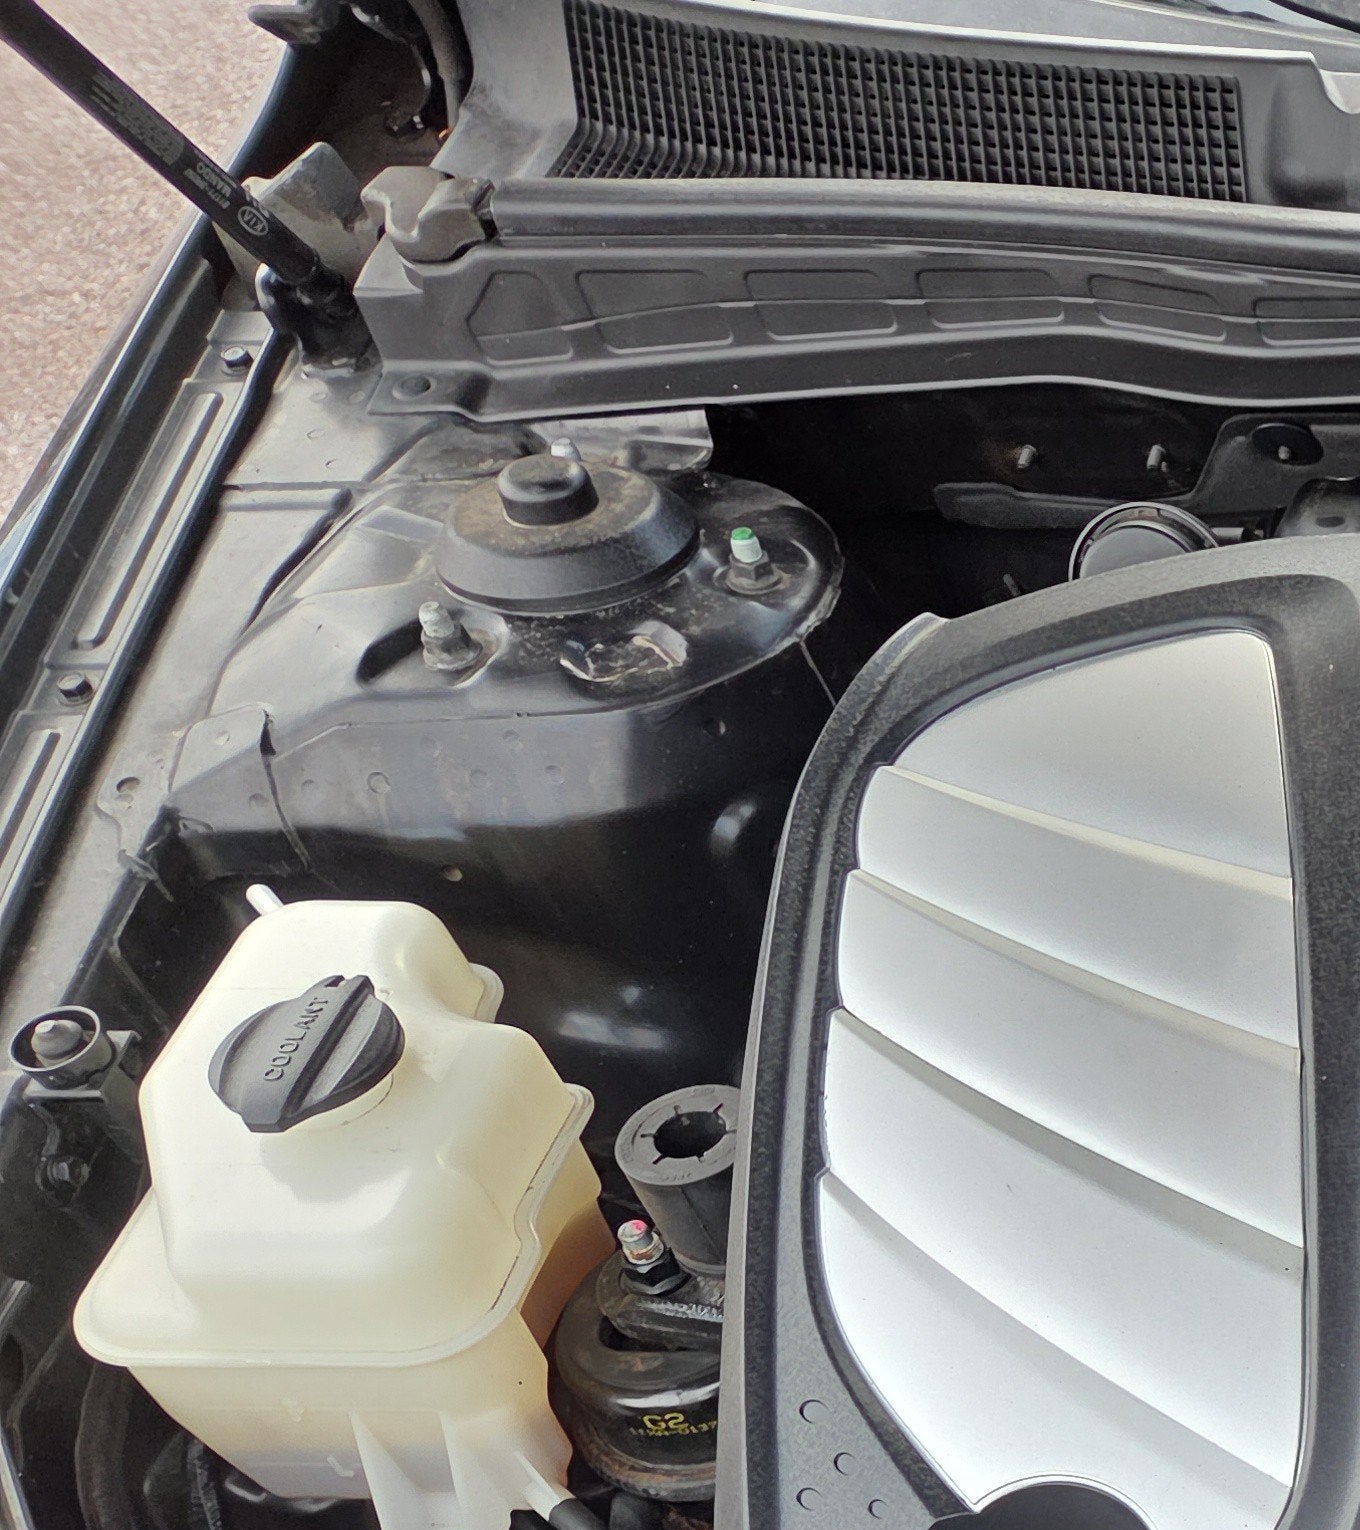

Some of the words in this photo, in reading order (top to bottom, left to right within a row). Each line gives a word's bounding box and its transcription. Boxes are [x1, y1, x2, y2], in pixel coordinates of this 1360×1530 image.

[197, 162, 233, 197] MANDO
[263, 997, 329, 1083] COOLANT
[642, 1412, 685, 1430] G2
